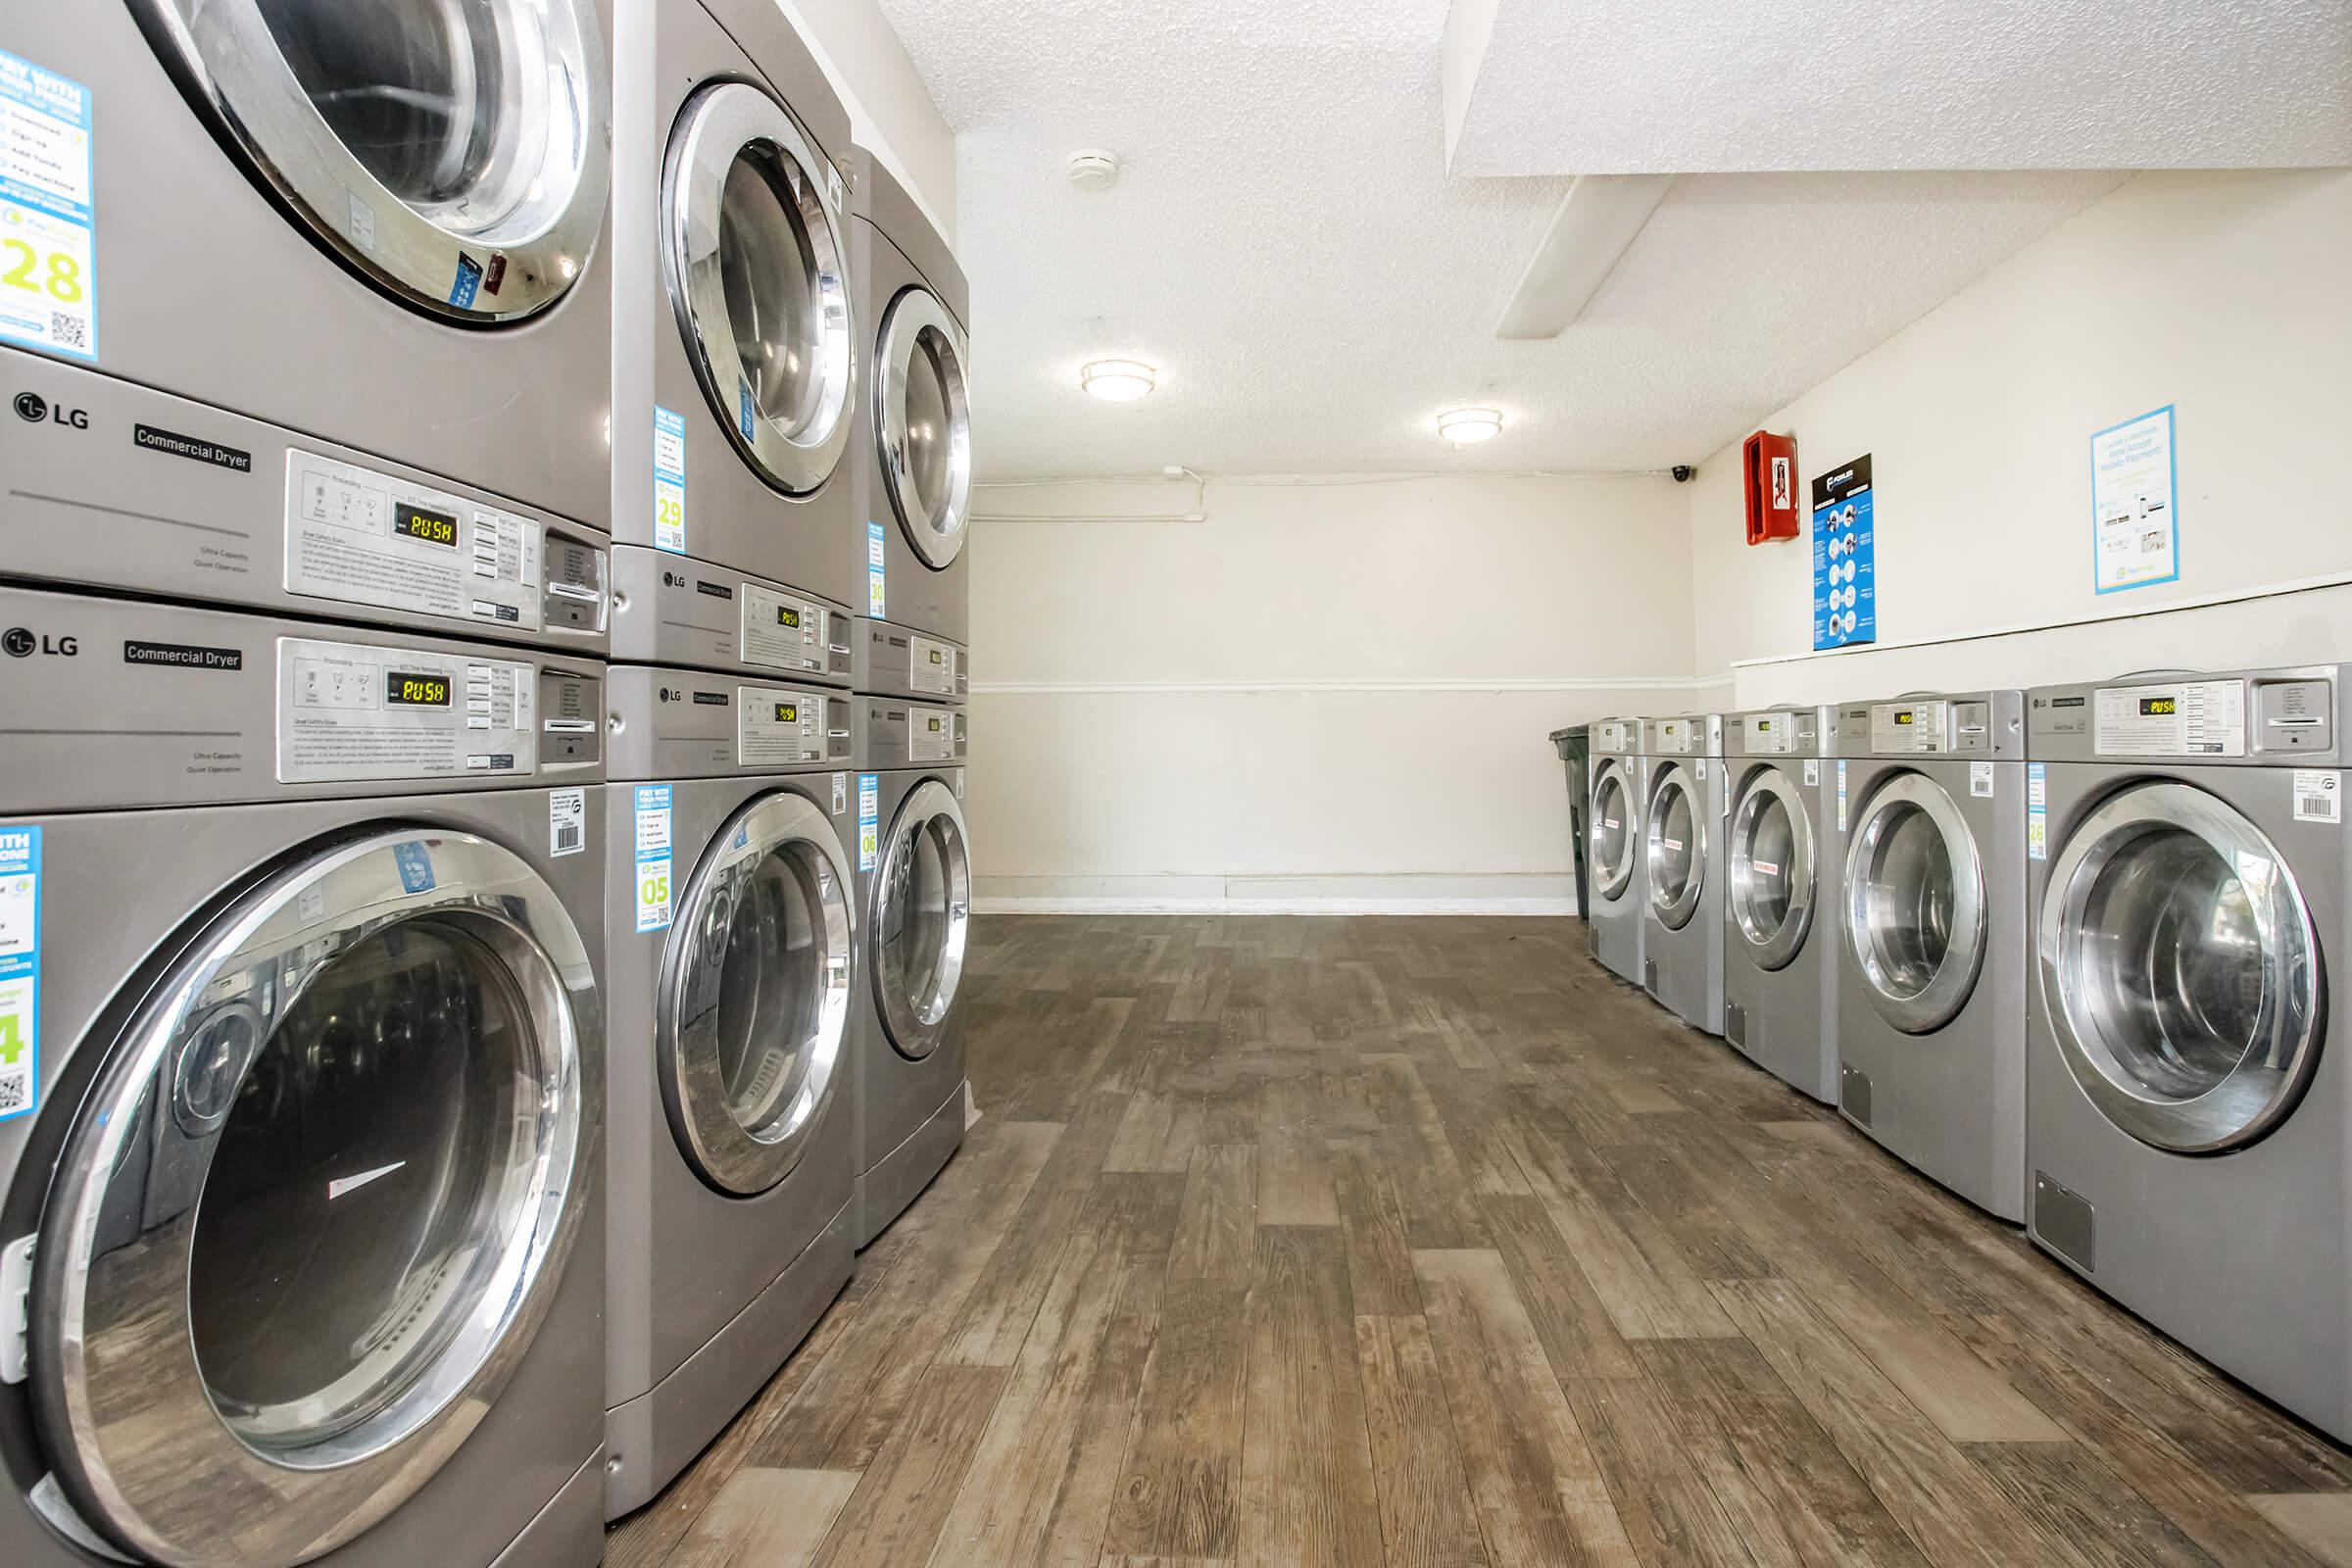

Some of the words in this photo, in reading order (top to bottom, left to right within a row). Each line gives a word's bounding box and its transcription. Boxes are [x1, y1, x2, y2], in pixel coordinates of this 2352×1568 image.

[31, 69, 81, 102] WITH
[2, 238, 82, 303] 28
[54, 404, 88, 429] LG
[137, 429, 213, 459] Commercial
[215, 449, 249, 467] Dryer
[332, 474, 361, 489] Processing
[659, 498, 681, 527] 29
[412, 515, 452, 541] PUSH
[201, 546, 219, 556] Ultra
[220, 549, 248, 562] Capacity
[194, 560, 214, 568] Quiet
[215, 563, 248, 573] Operation
[674, 576, 685, 588] LG
[871, 584, 883, 600] 30
[43, 635, 77, 657] LG
[127, 646, 203, 663] Commercial
[206, 652, 239, 667] Dryer
[323, 658, 353, 667] Processing
[403, 681, 444, 702] PUSH
[670, 690, 681, 702] LG
[2039, 699, 2047, 708] LG
[213, 752, 241, 760] Capacity
[639, 789, 654, 799] PAY
[2030, 824, 2043, 842] 26
[862, 835, 875, 854] 06
[642, 877, 668, 905] 05
